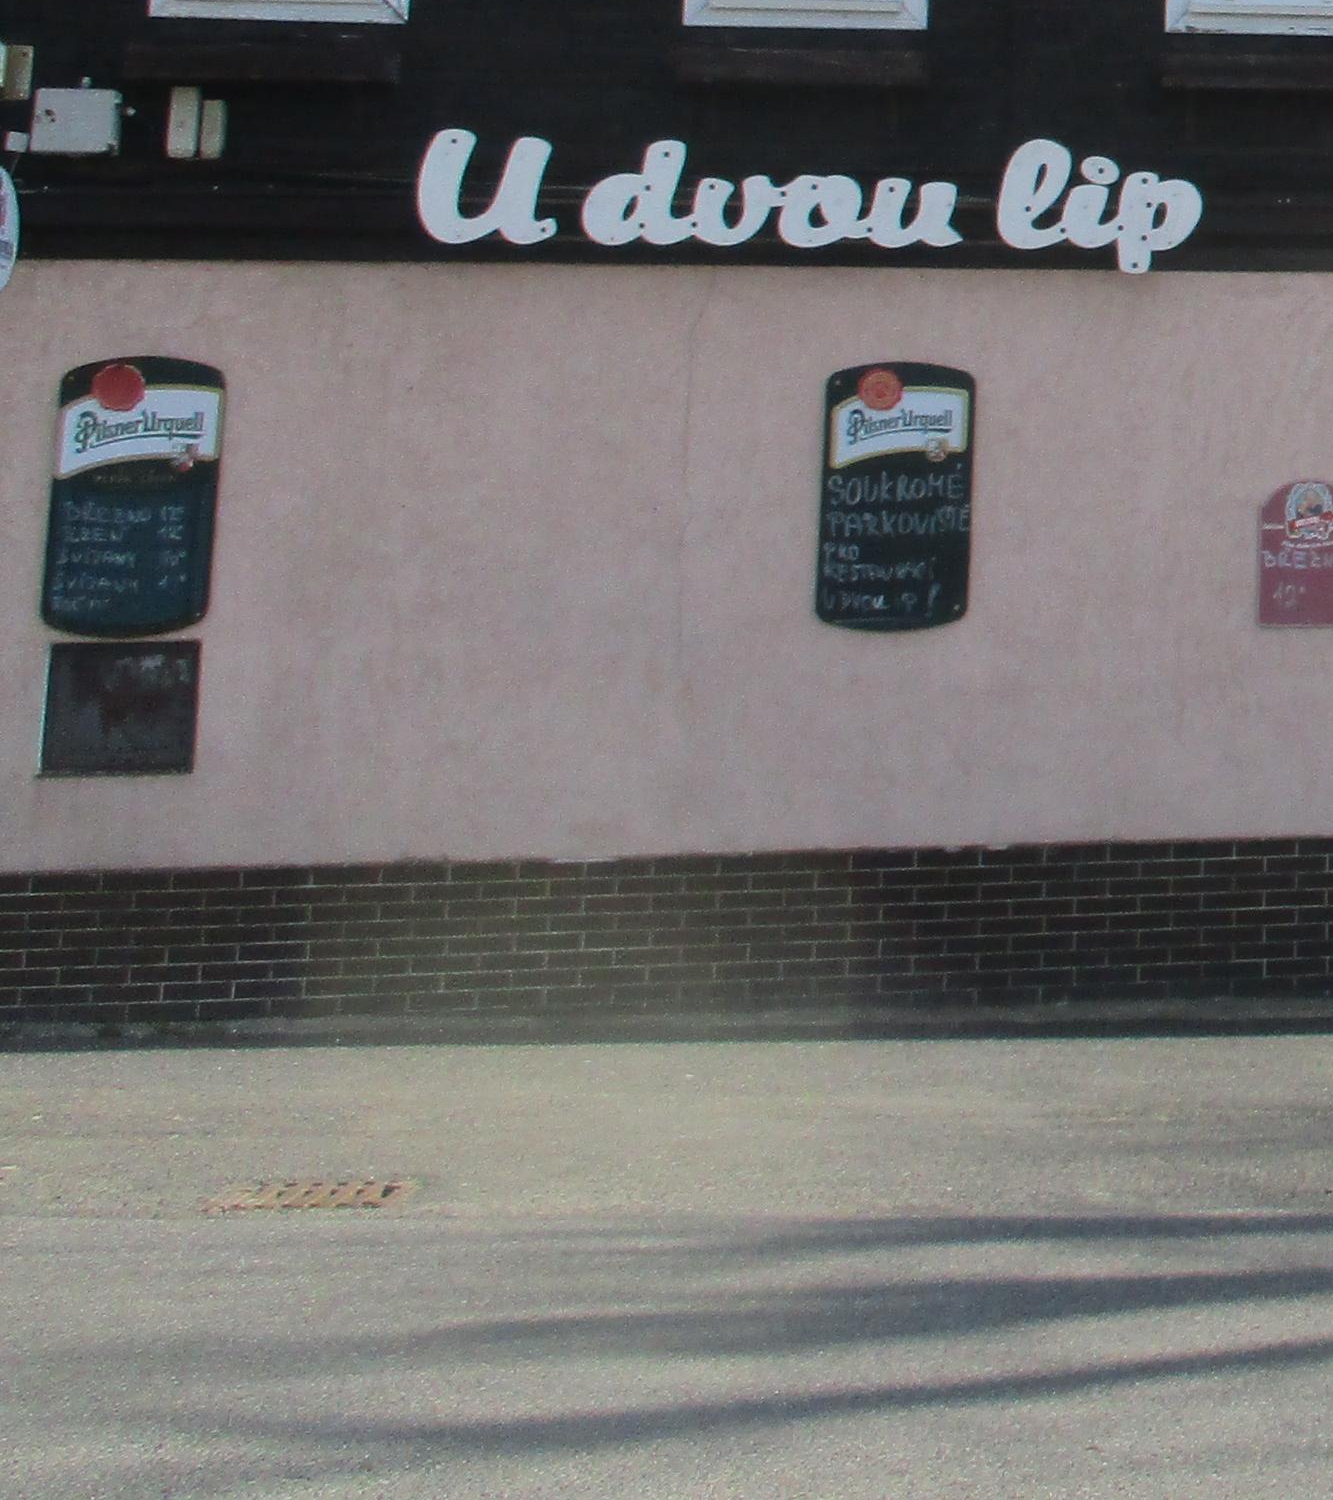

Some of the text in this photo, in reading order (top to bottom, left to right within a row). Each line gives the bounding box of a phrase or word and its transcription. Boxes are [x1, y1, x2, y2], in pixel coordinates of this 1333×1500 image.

[416, 127, 1202, 275] U dvou lip
[74, 409, 205, 454] Pilsner Urquell
[846, 408, 953, 446] Pilsner Urquell
